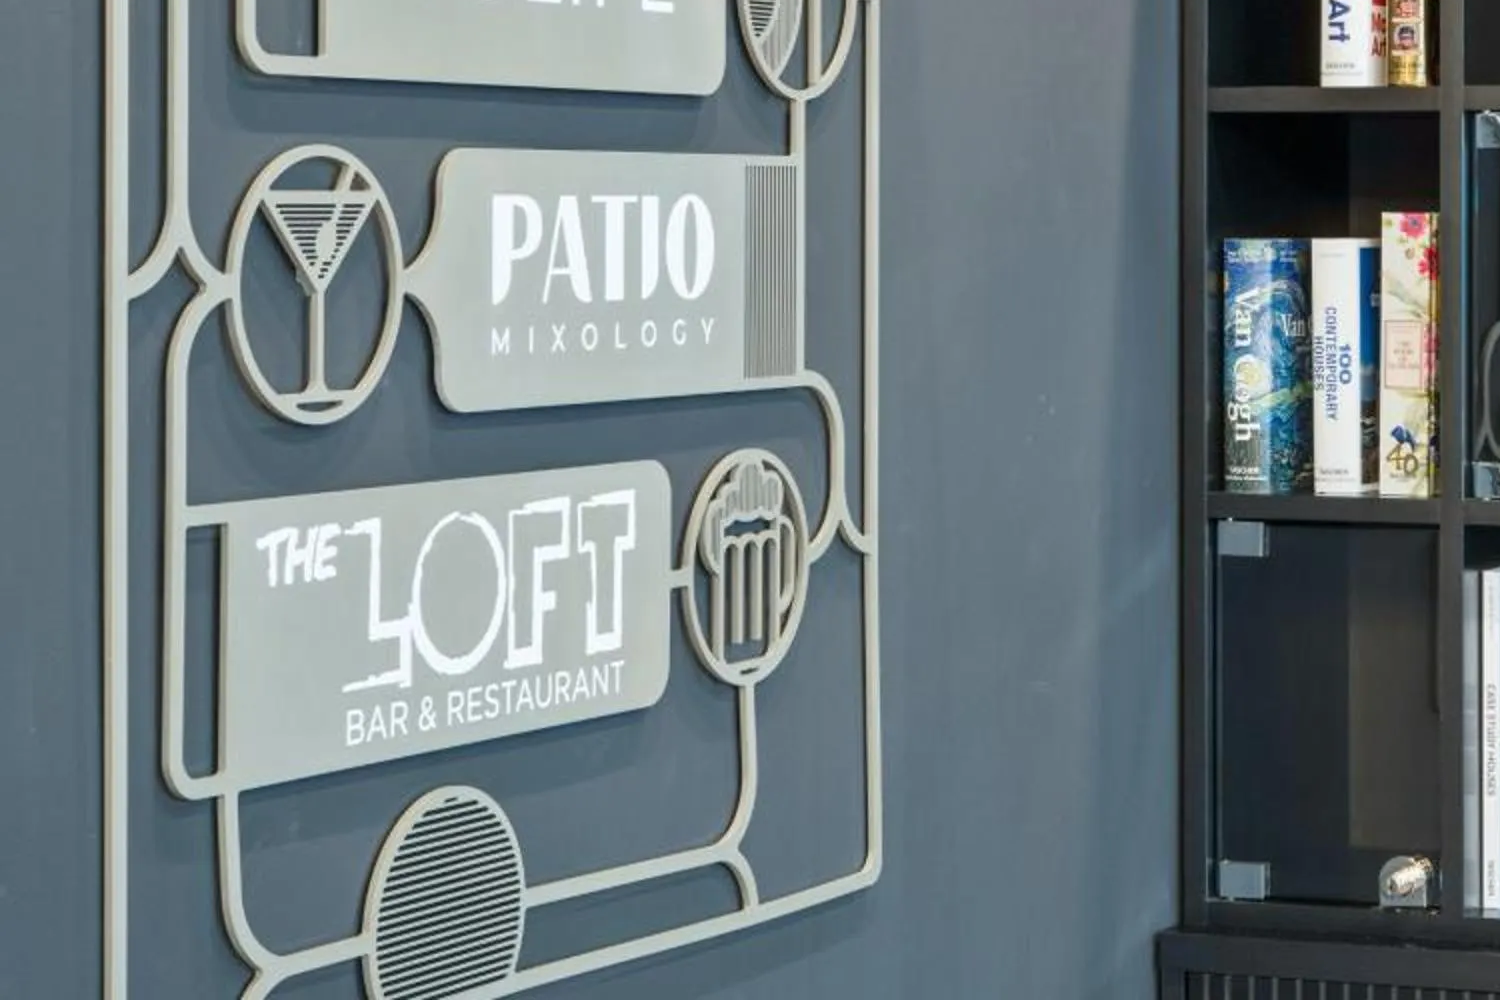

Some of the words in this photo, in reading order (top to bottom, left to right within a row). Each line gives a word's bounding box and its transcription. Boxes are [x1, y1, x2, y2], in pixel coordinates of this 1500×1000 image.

[1327, 0, 1352, 43] Art
[491, 193, 716, 306] PATIO
[491, 317, 716, 356] MIXOLOGY
[1234, 287, 1262, 348] Van
[1279, 313, 1306, 338] Van
[1314, 336, 1325, 391] HOUSES
[1325, 306, 1339, 421] CONTEMPORARY
[1338, 344, 1353, 386] 100
[1227, 354, 1262, 443] Gogh
[1386, 448, 1419, 475] 40
[255, 521, 340, 589] THE
[342, 487, 637, 694] LOFT
[344, 702, 410, 748] BAR
[418, 695, 439, 731] &
[446, 658, 627, 726] RESTAURANT
[1486, 683, 1497, 711] CASE
[1486, 713, 1497, 749] STUDY
